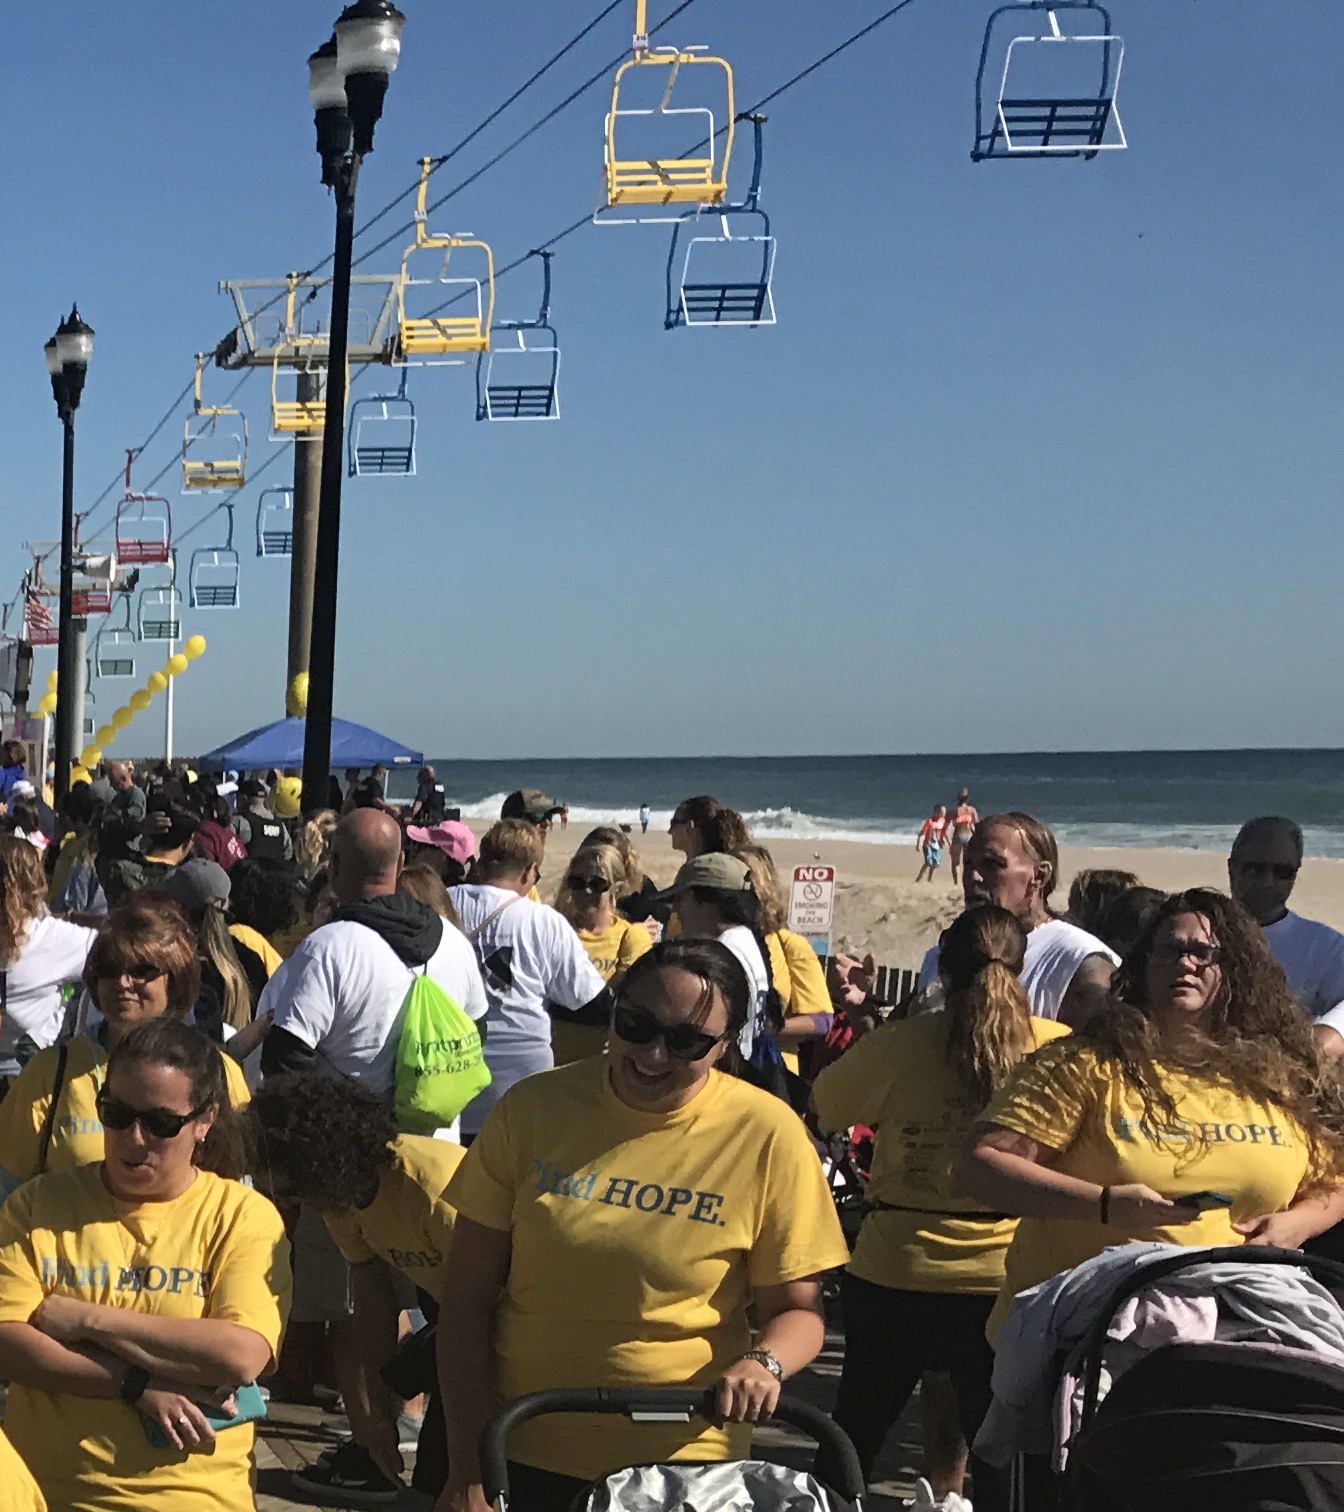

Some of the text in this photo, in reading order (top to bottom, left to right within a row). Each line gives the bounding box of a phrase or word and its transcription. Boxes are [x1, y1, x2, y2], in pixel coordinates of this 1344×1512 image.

[798, 868, 829, 880] NO
[797, 916, 823, 924] BEACH
[598, 1177, 726, 1227] HOPE.
